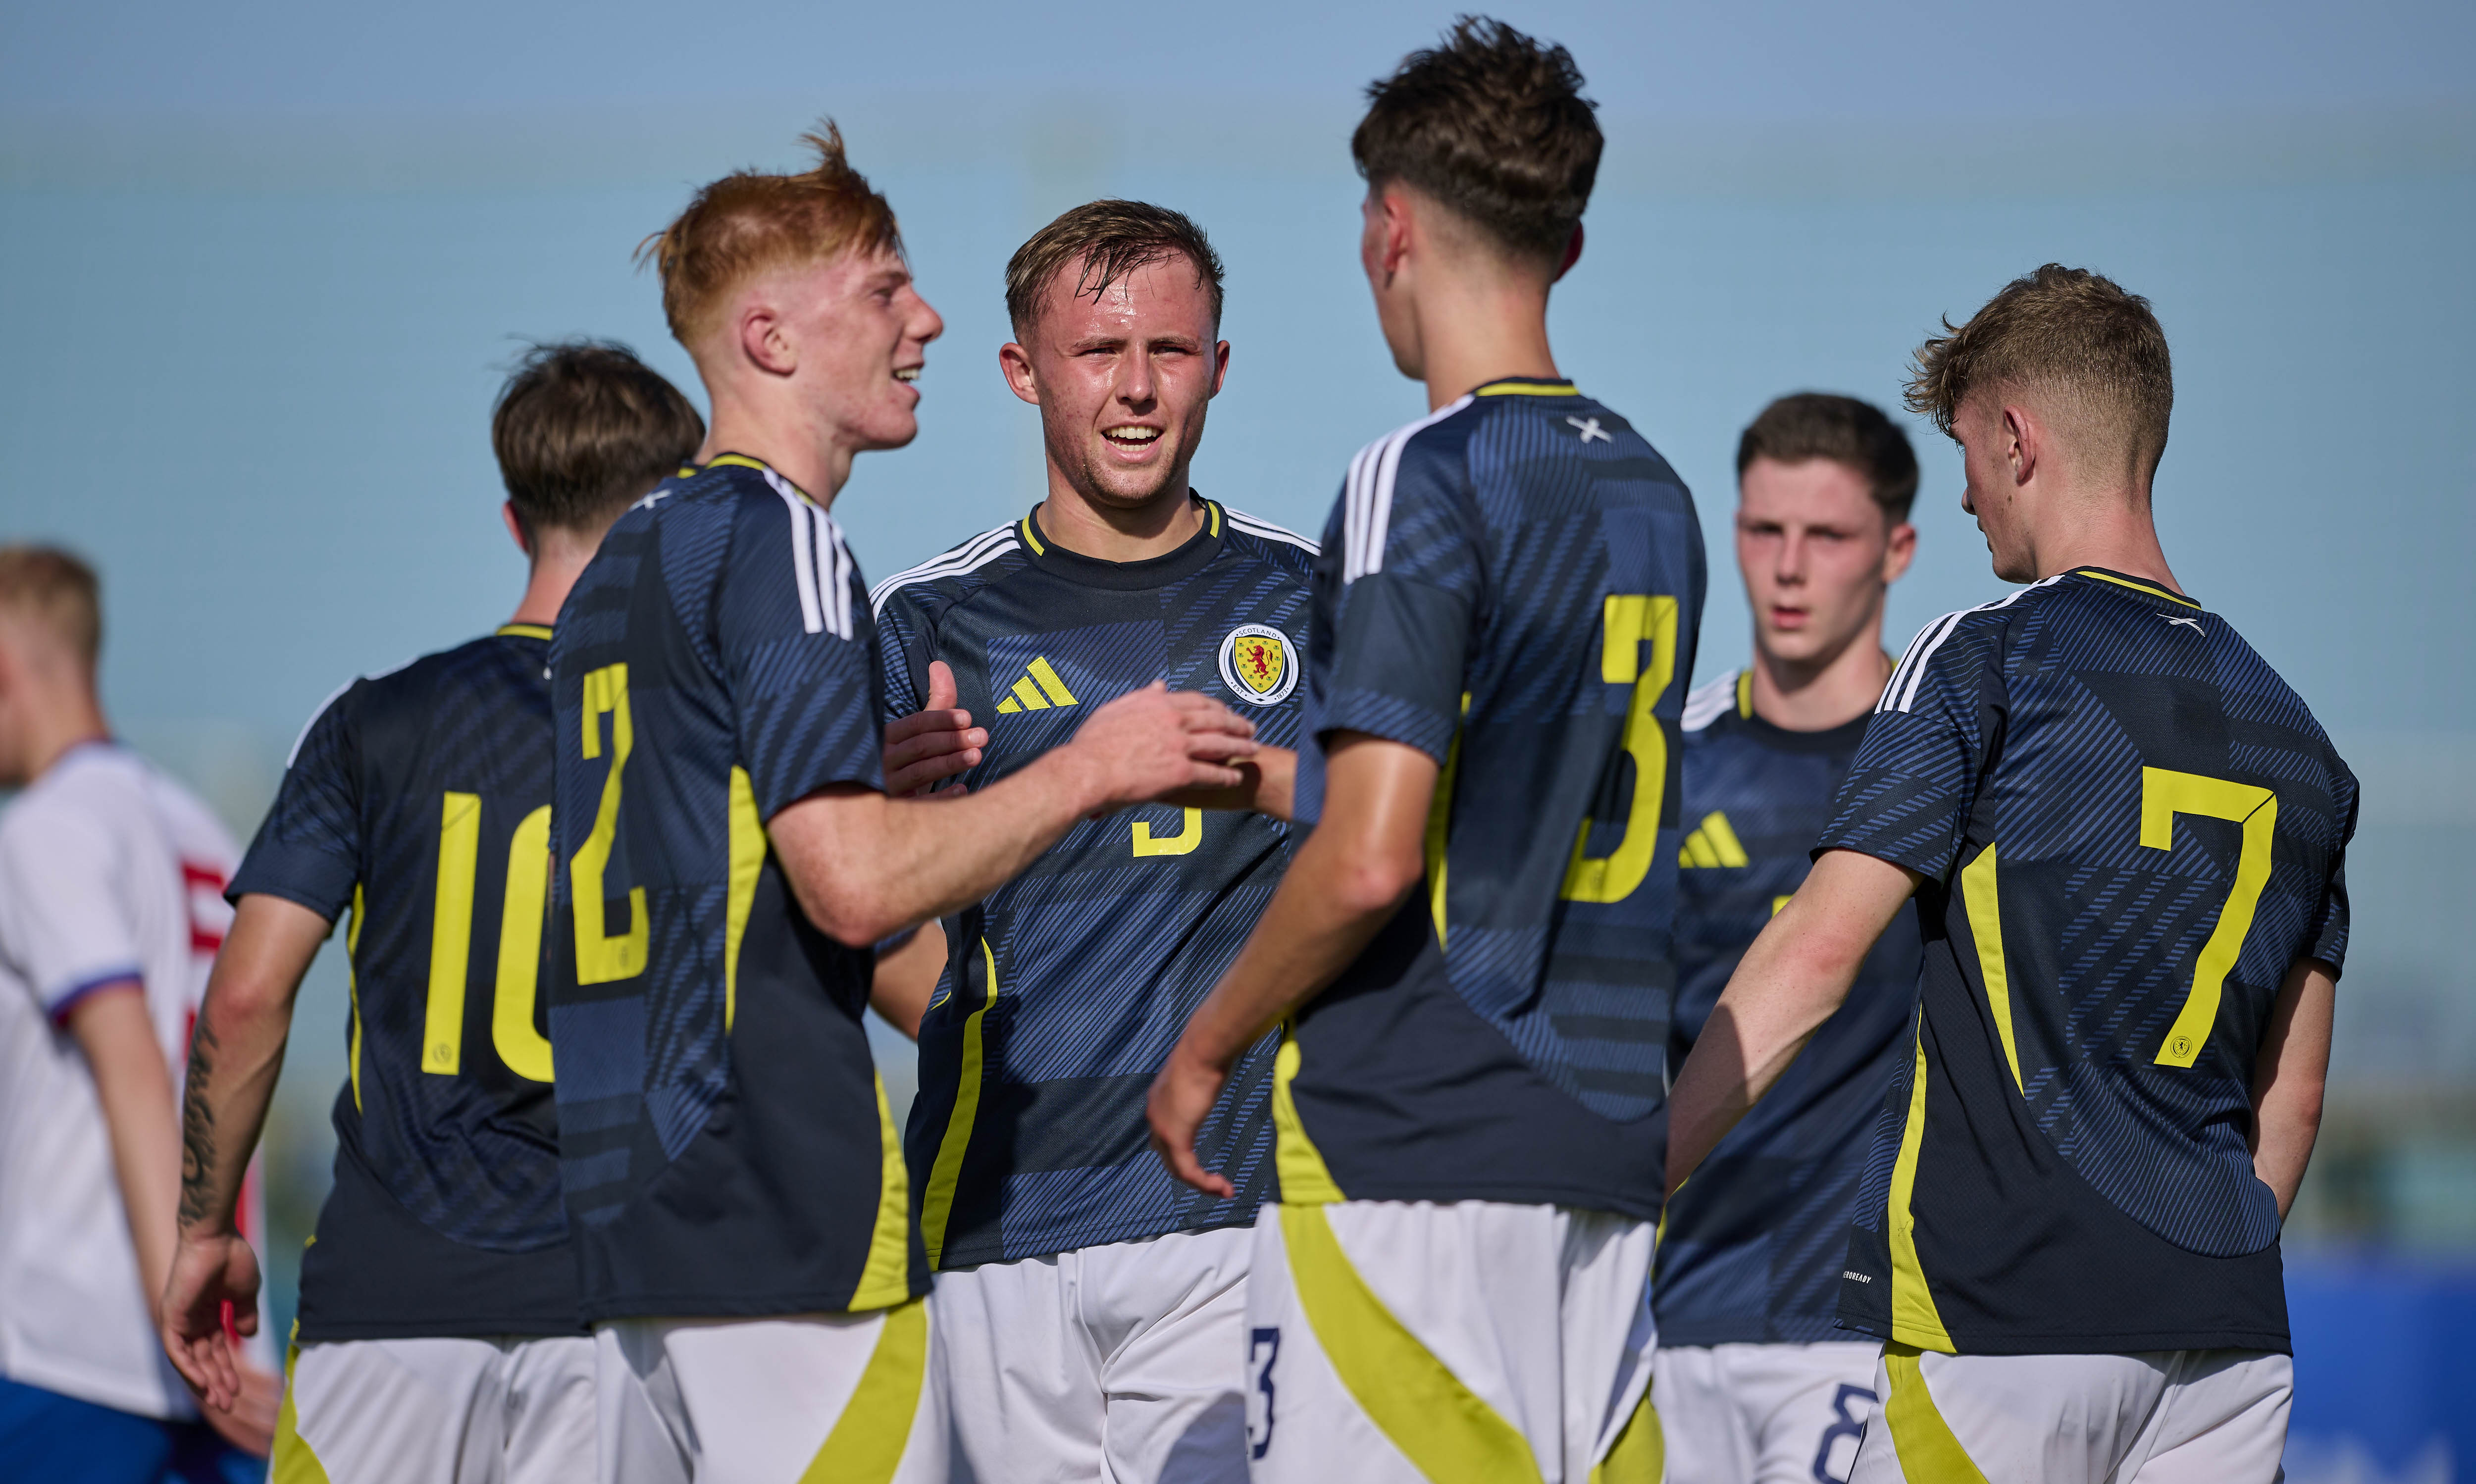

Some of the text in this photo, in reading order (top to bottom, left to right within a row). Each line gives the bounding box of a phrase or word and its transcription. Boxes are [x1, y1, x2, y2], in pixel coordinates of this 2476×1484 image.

[1233, 684, 1288, 700] EST 1873
[1239, 628, 1277, 638] SCOTLAND
[1559, 594, 1678, 903] 3
[570, 662, 650, 985] 2
[2139, 766, 2277, 1068] 7
[1247, 1328, 1280, 1460] 3
[1813, 1383, 1878, 1484] 8
